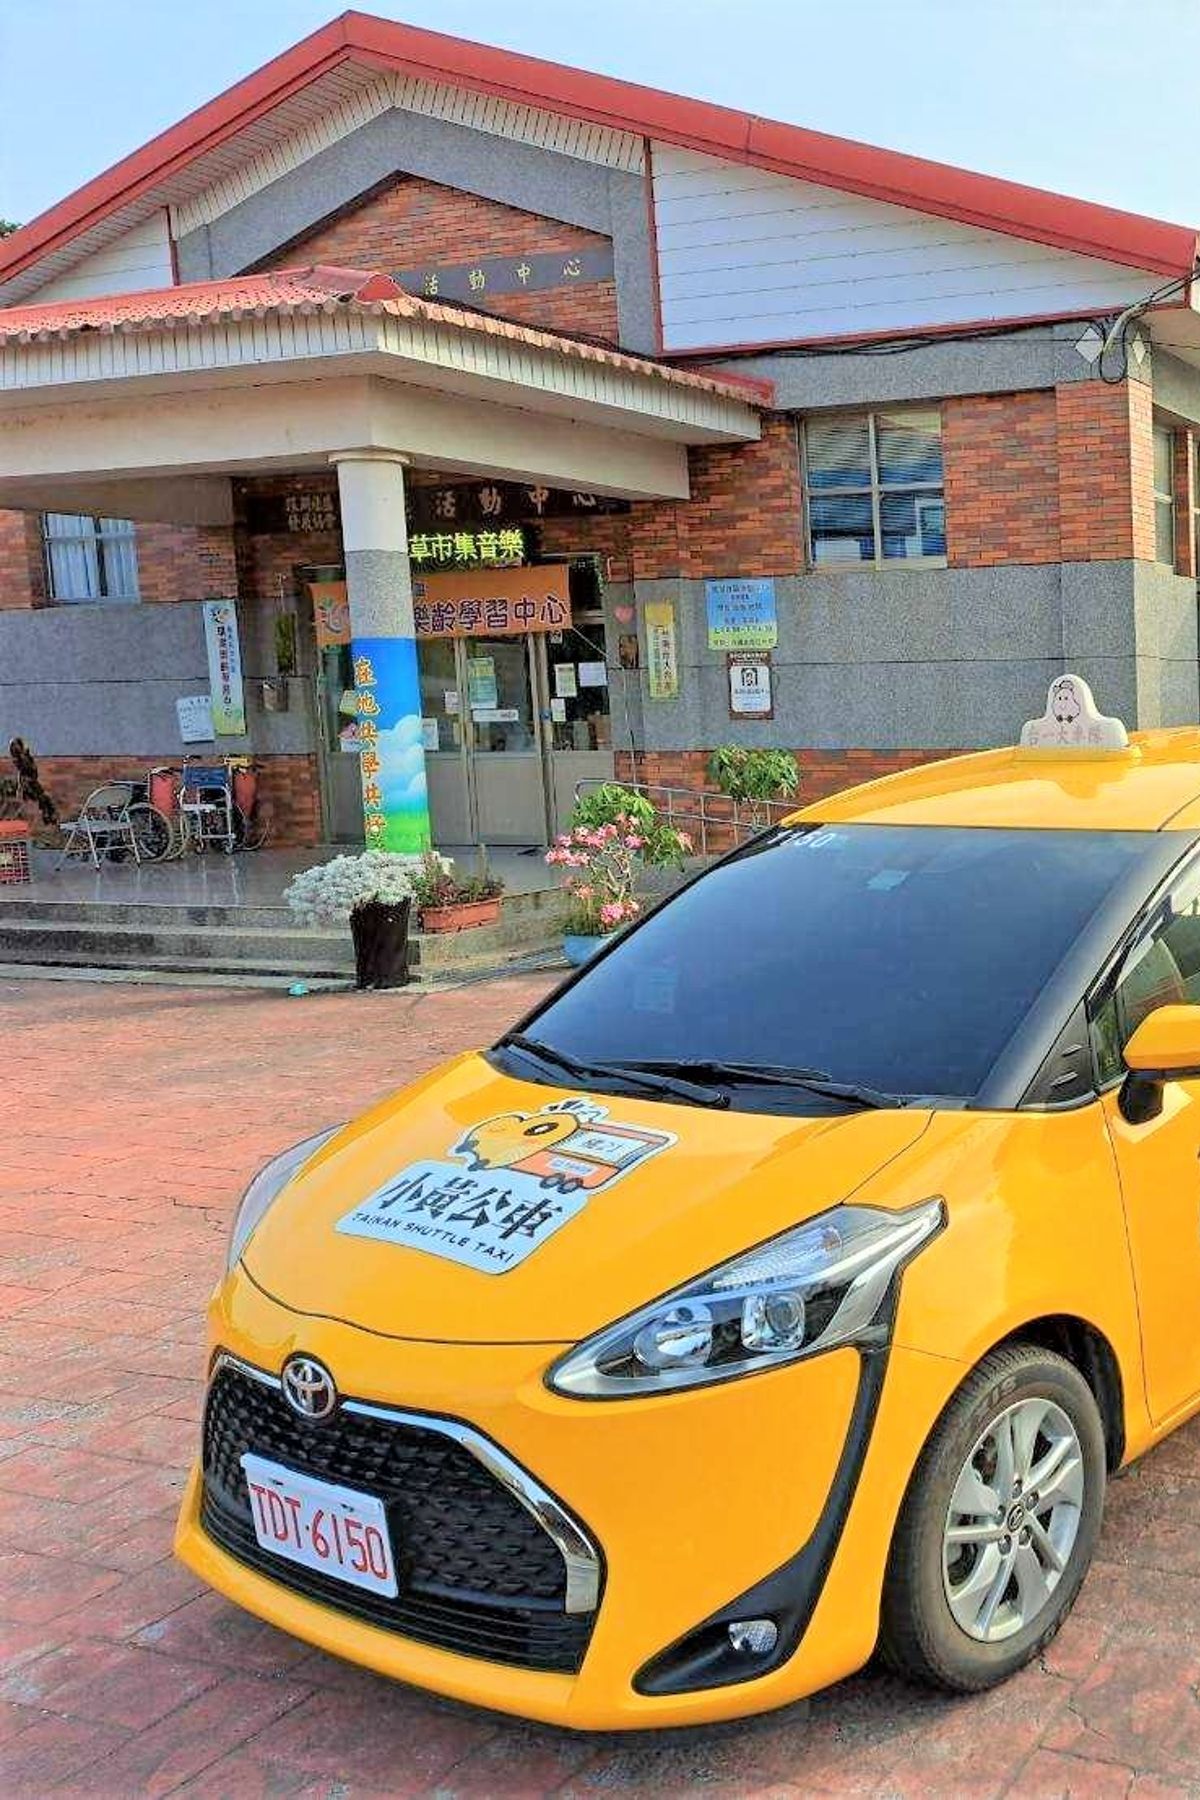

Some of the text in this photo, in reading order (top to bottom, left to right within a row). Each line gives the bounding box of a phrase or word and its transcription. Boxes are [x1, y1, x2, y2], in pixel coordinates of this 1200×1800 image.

[424, 258, 583, 296] 活動中心
[380, 1172, 563, 1240] 小黃公車
[353, 1212, 514, 1264] TAINAN SHUTTLE TAXI
